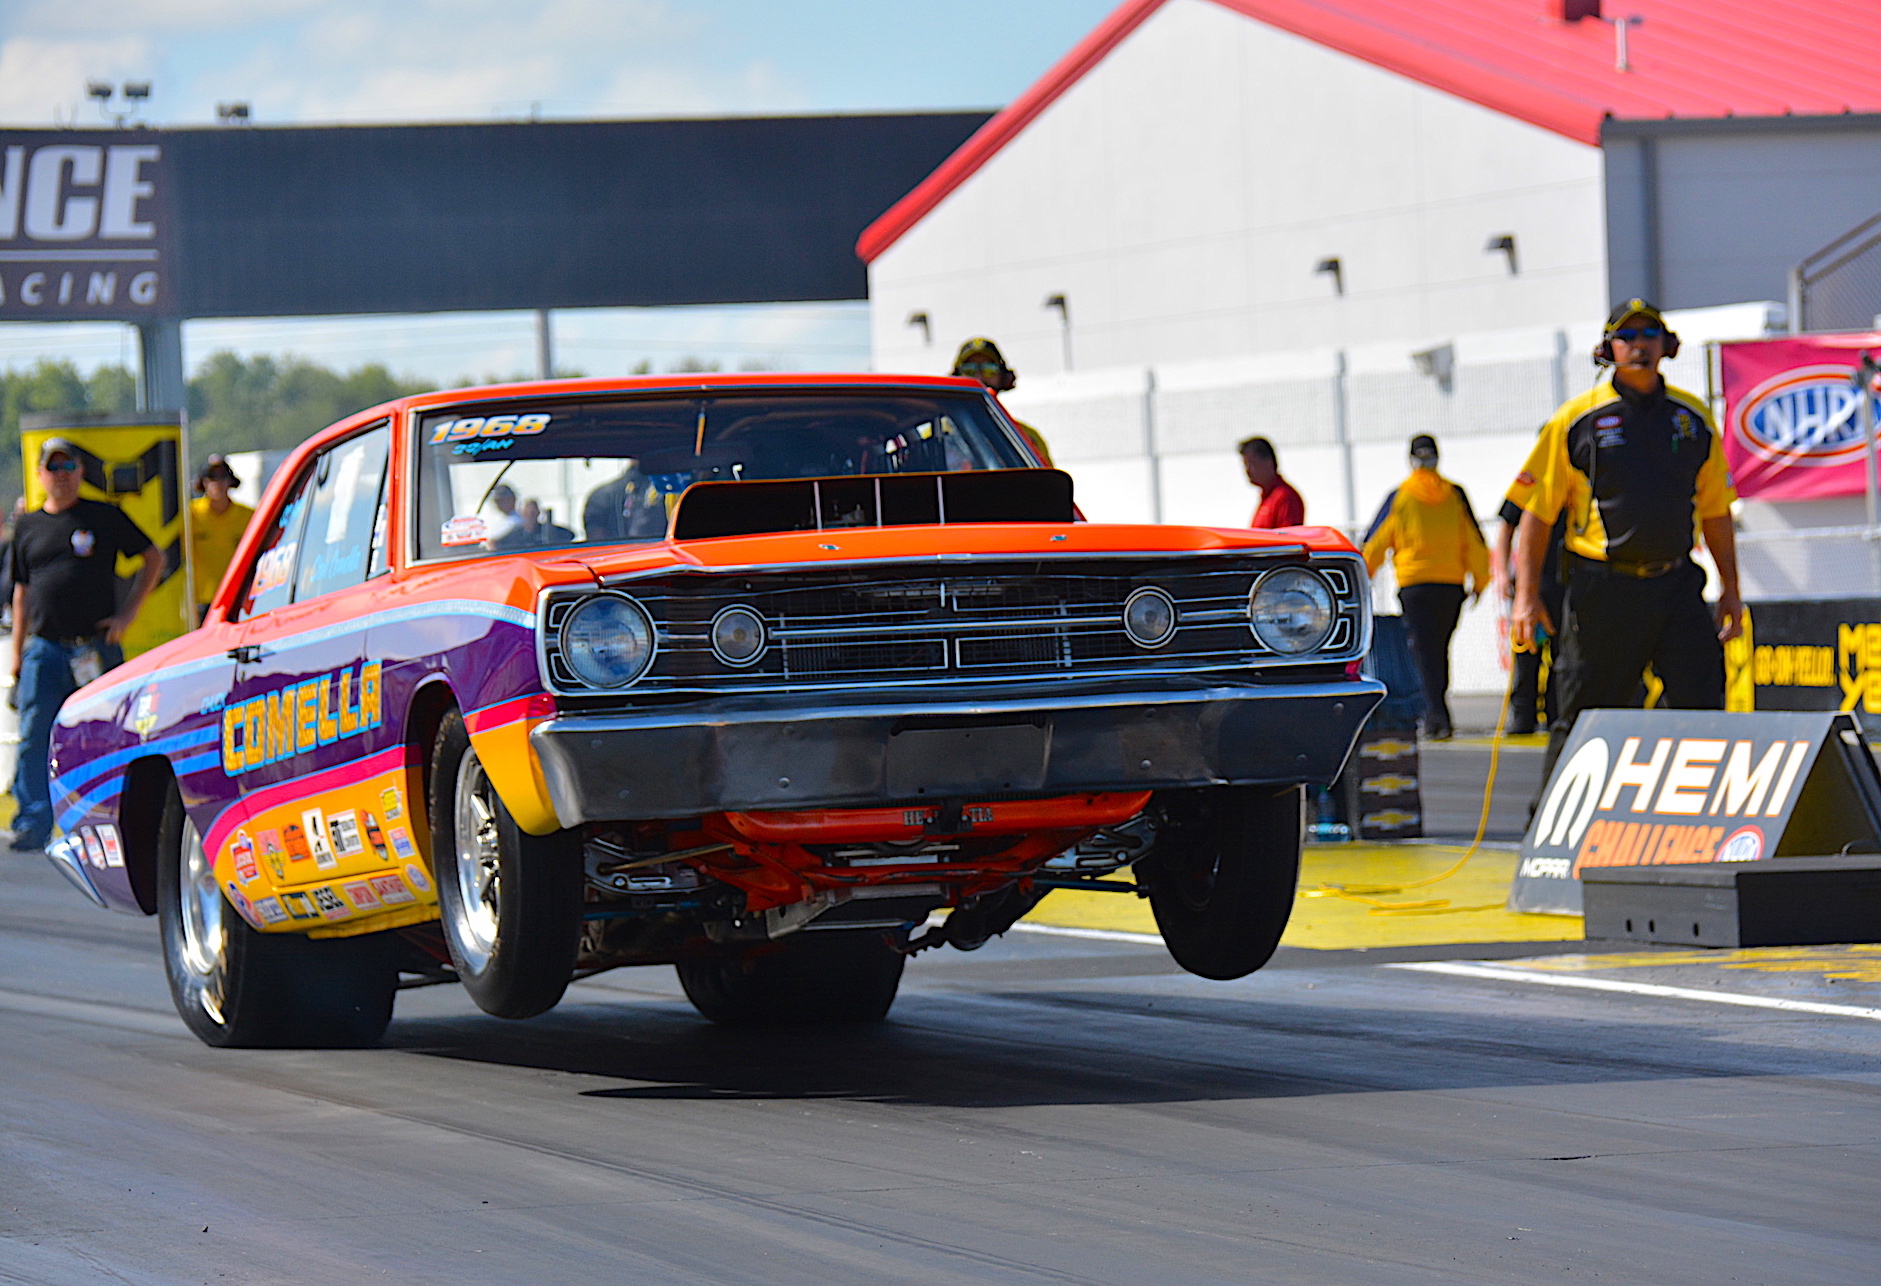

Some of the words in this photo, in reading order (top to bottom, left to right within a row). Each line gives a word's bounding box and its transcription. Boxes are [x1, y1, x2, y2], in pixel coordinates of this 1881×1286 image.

[428, 413, 551, 445] 1968
[222, 659, 383, 777] COMELLA
[1599, 737, 1811, 818] HEMI
